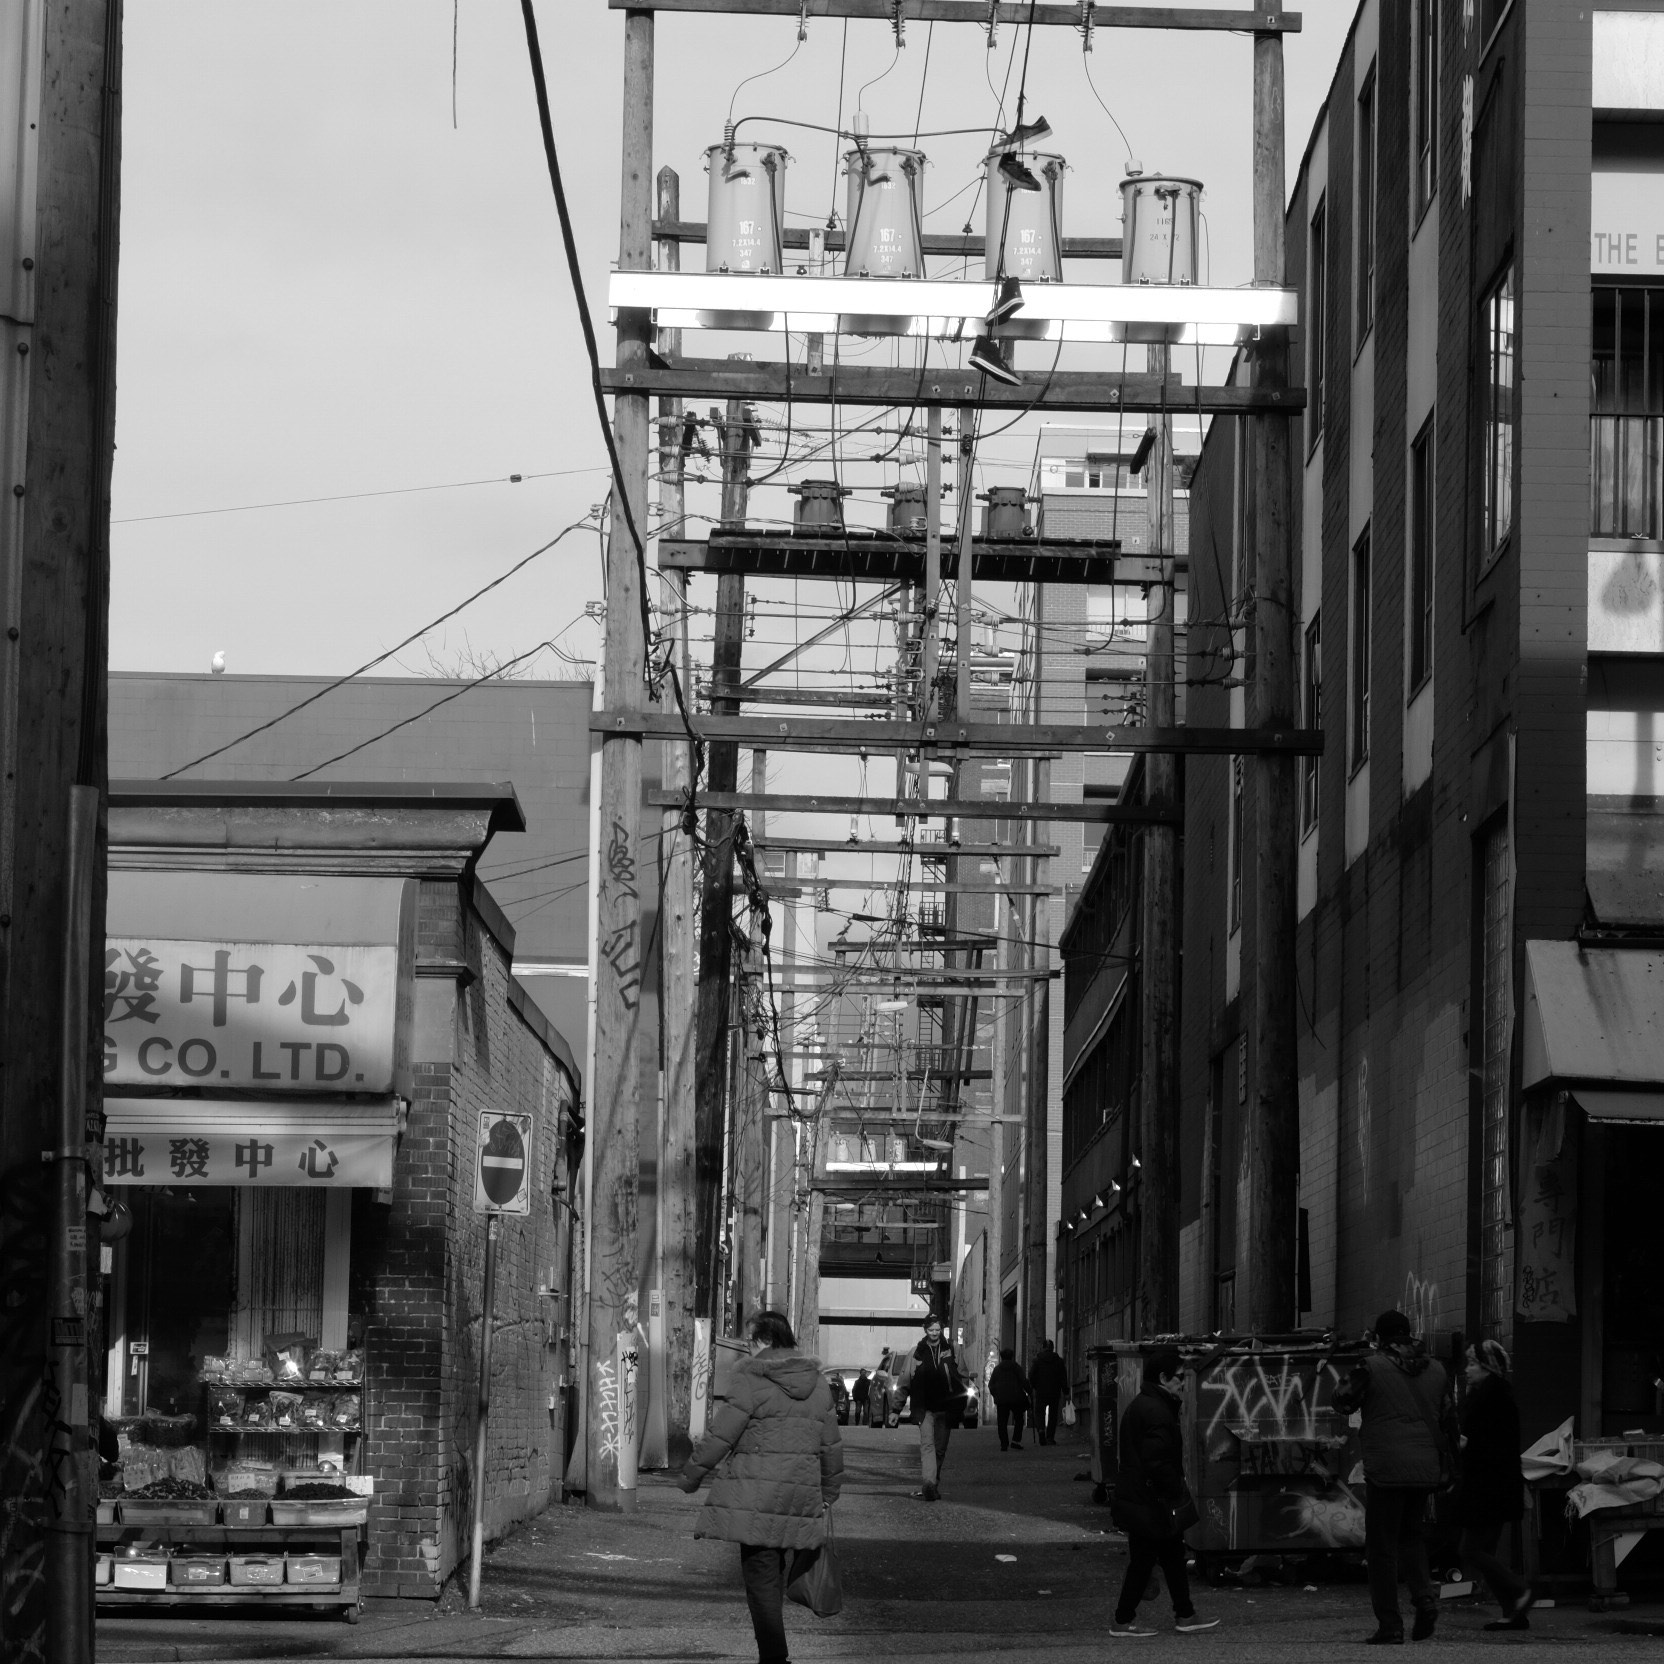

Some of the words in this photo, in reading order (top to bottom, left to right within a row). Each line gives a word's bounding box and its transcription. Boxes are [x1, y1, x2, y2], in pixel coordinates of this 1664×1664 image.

[739, 220, 755, 235] 167
[880, 228, 895, 243] 167
[1020, 229, 1036, 244] 167
[739, 249, 752, 258] 347
[1594, 232, 1638, 265] THE
[880, 255, 894, 263] 347
[1020, 258, 1033, 266] 347
[137, 1036, 230, 1078] CO.
[252, 1041, 365, 1082] LTD.
[103, 1137, 340, 1180] 批發中心
